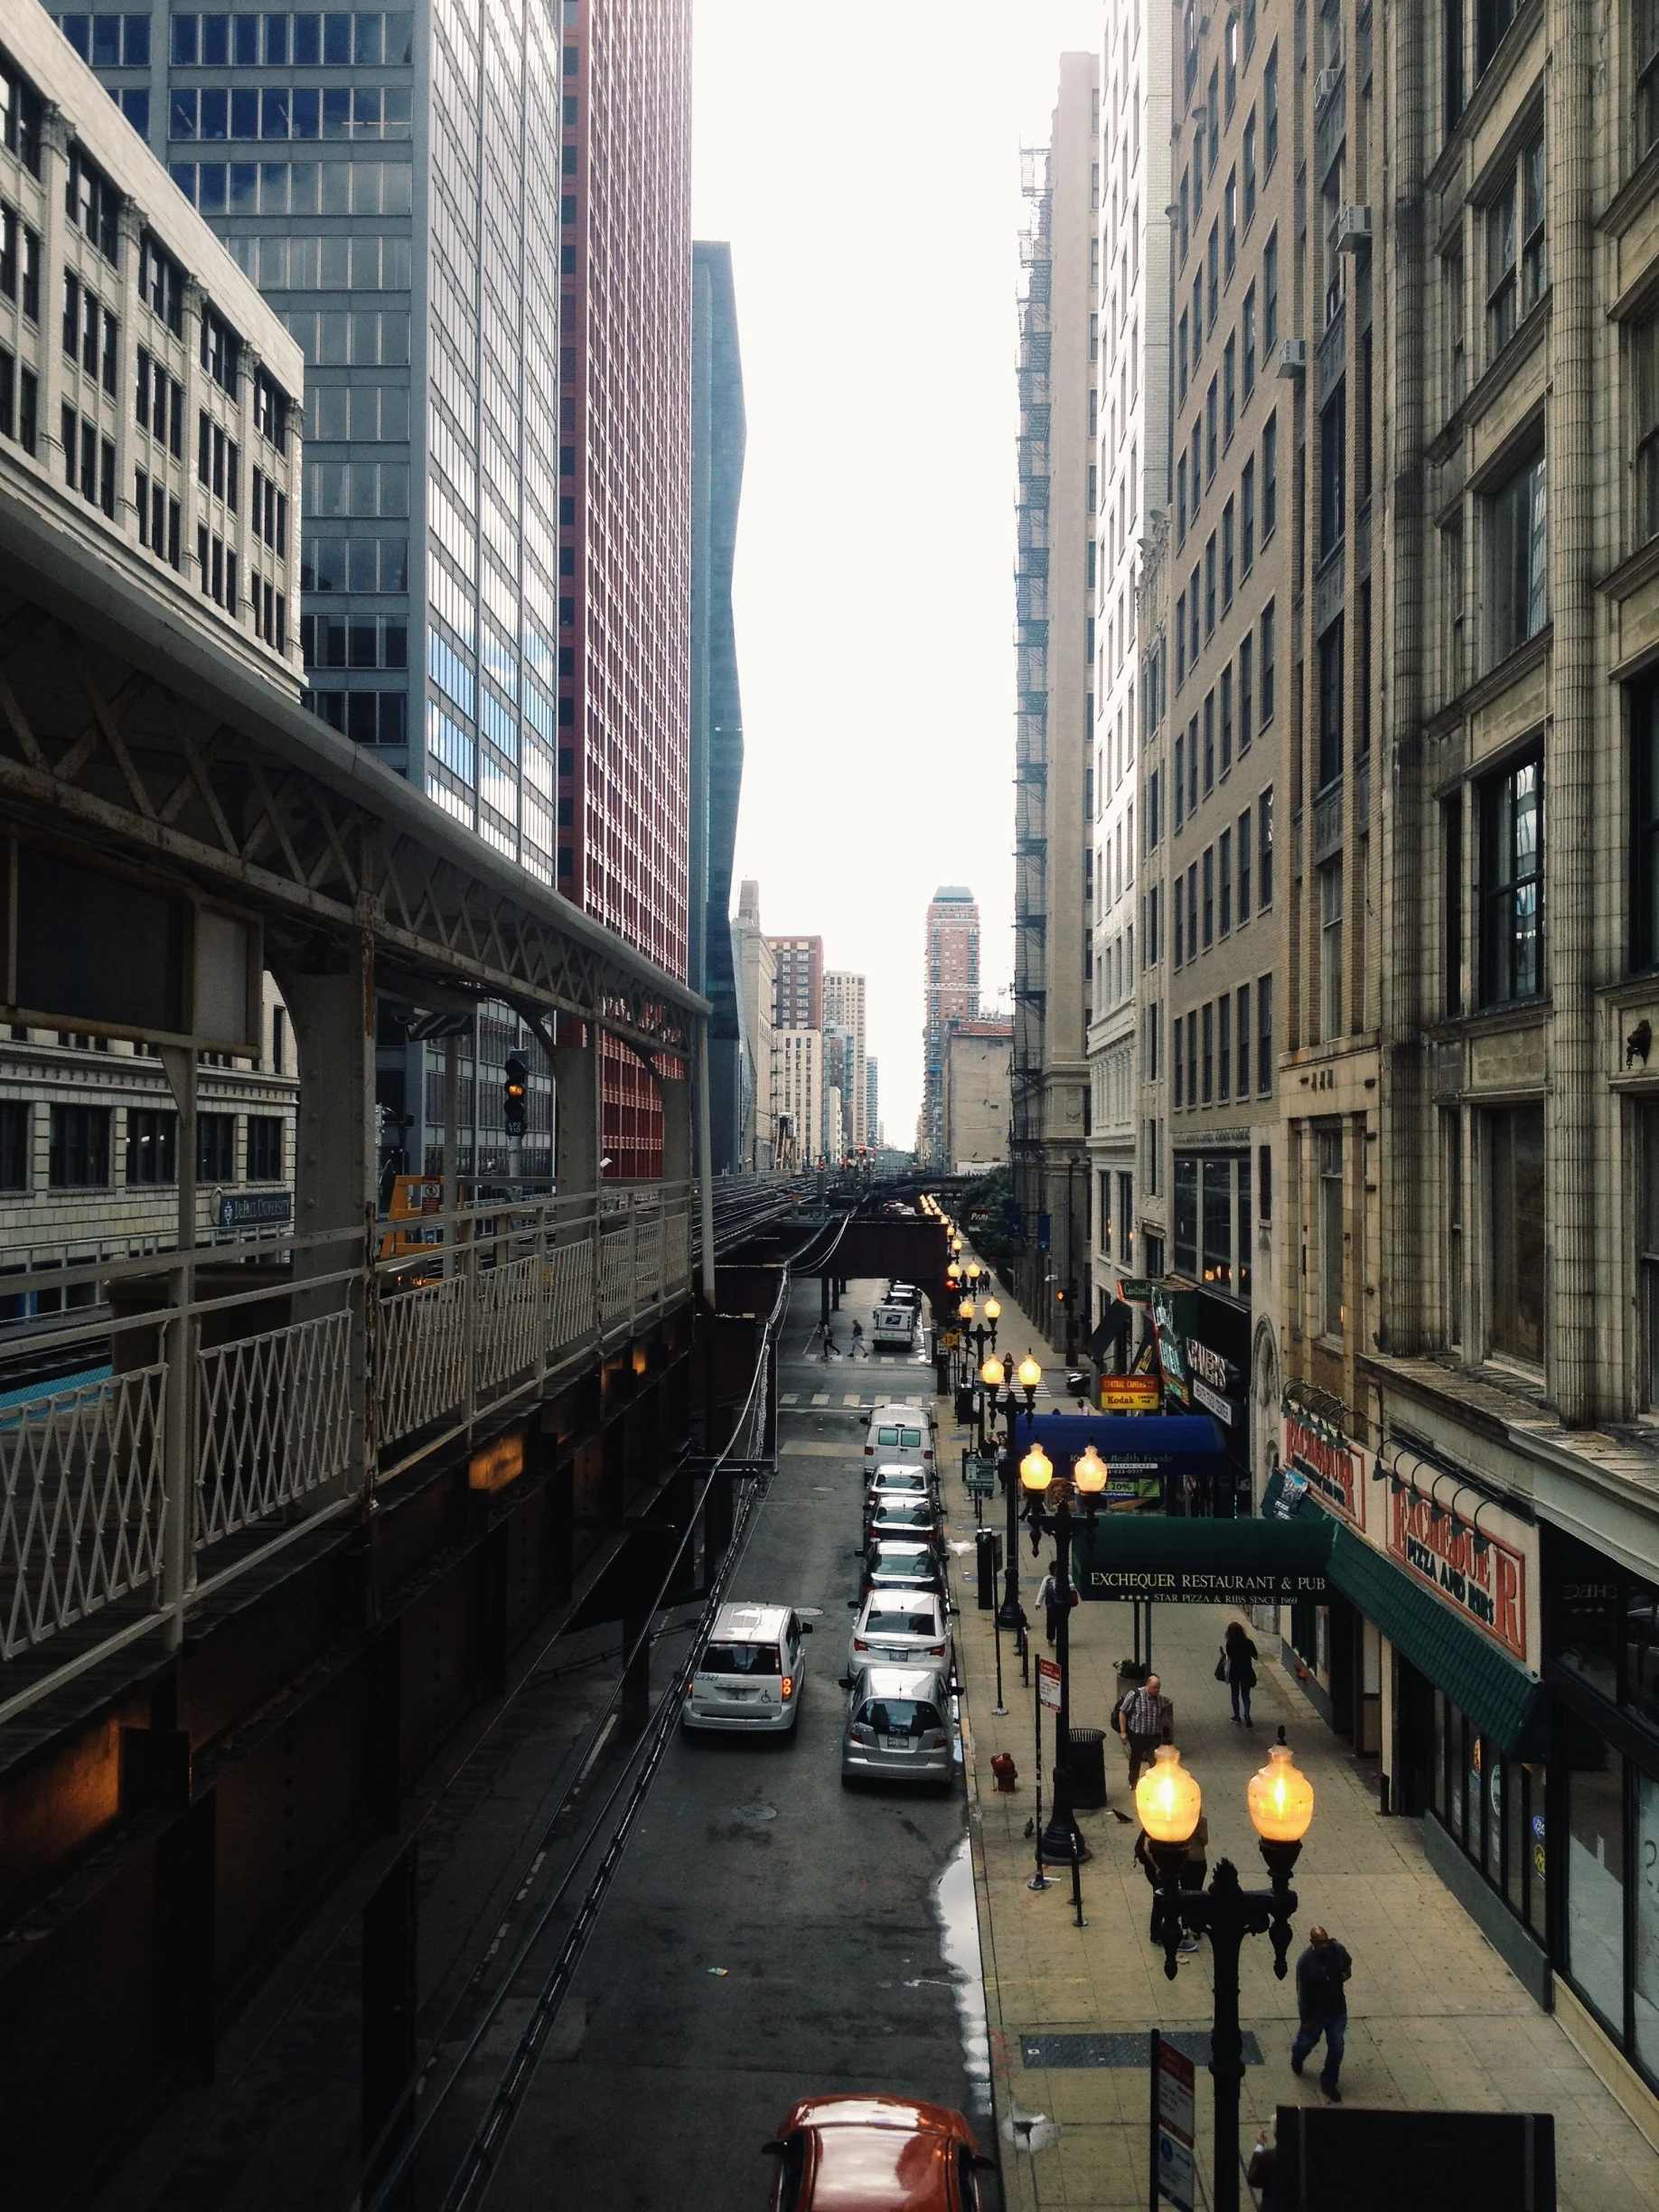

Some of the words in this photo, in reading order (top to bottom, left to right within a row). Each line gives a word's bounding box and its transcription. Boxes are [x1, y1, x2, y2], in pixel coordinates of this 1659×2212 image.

[1104, 1380, 1125, 1389] CENTRAL
[1127, 1381, 1147, 1389] CAMERA
[1107, 1396, 1134, 1404] Kodak
[1111, 1454, 1140, 1463] Health
[1143, 1454, 1173, 1463] Foods
[1111, 1483, 1132, 1491] 20%
[1091, 1572, 1176, 1589] EXCHEQUER
[1182, 1574, 1276, 1590] RESTAURANT
[1281, 1577, 1292, 1589] &
[1298, 1577, 1326, 1590] PUB
[1407, 1535, 1439, 1583] PIZZA
[1439, 1561, 1466, 1604] AND
[1467, 1581, 1495, 1626] RIBS
[1154, 1594, 1178, 1602] STAR
[1182, 1594, 1210, 1603] PIZZA
[1214, 1595, 1222, 1603] &
[1225, 1595, 1246, 1604] RIBS
[1249, 1596, 1278, 1605] SINCE
[1280, 1597, 1298, 1605] 1969
